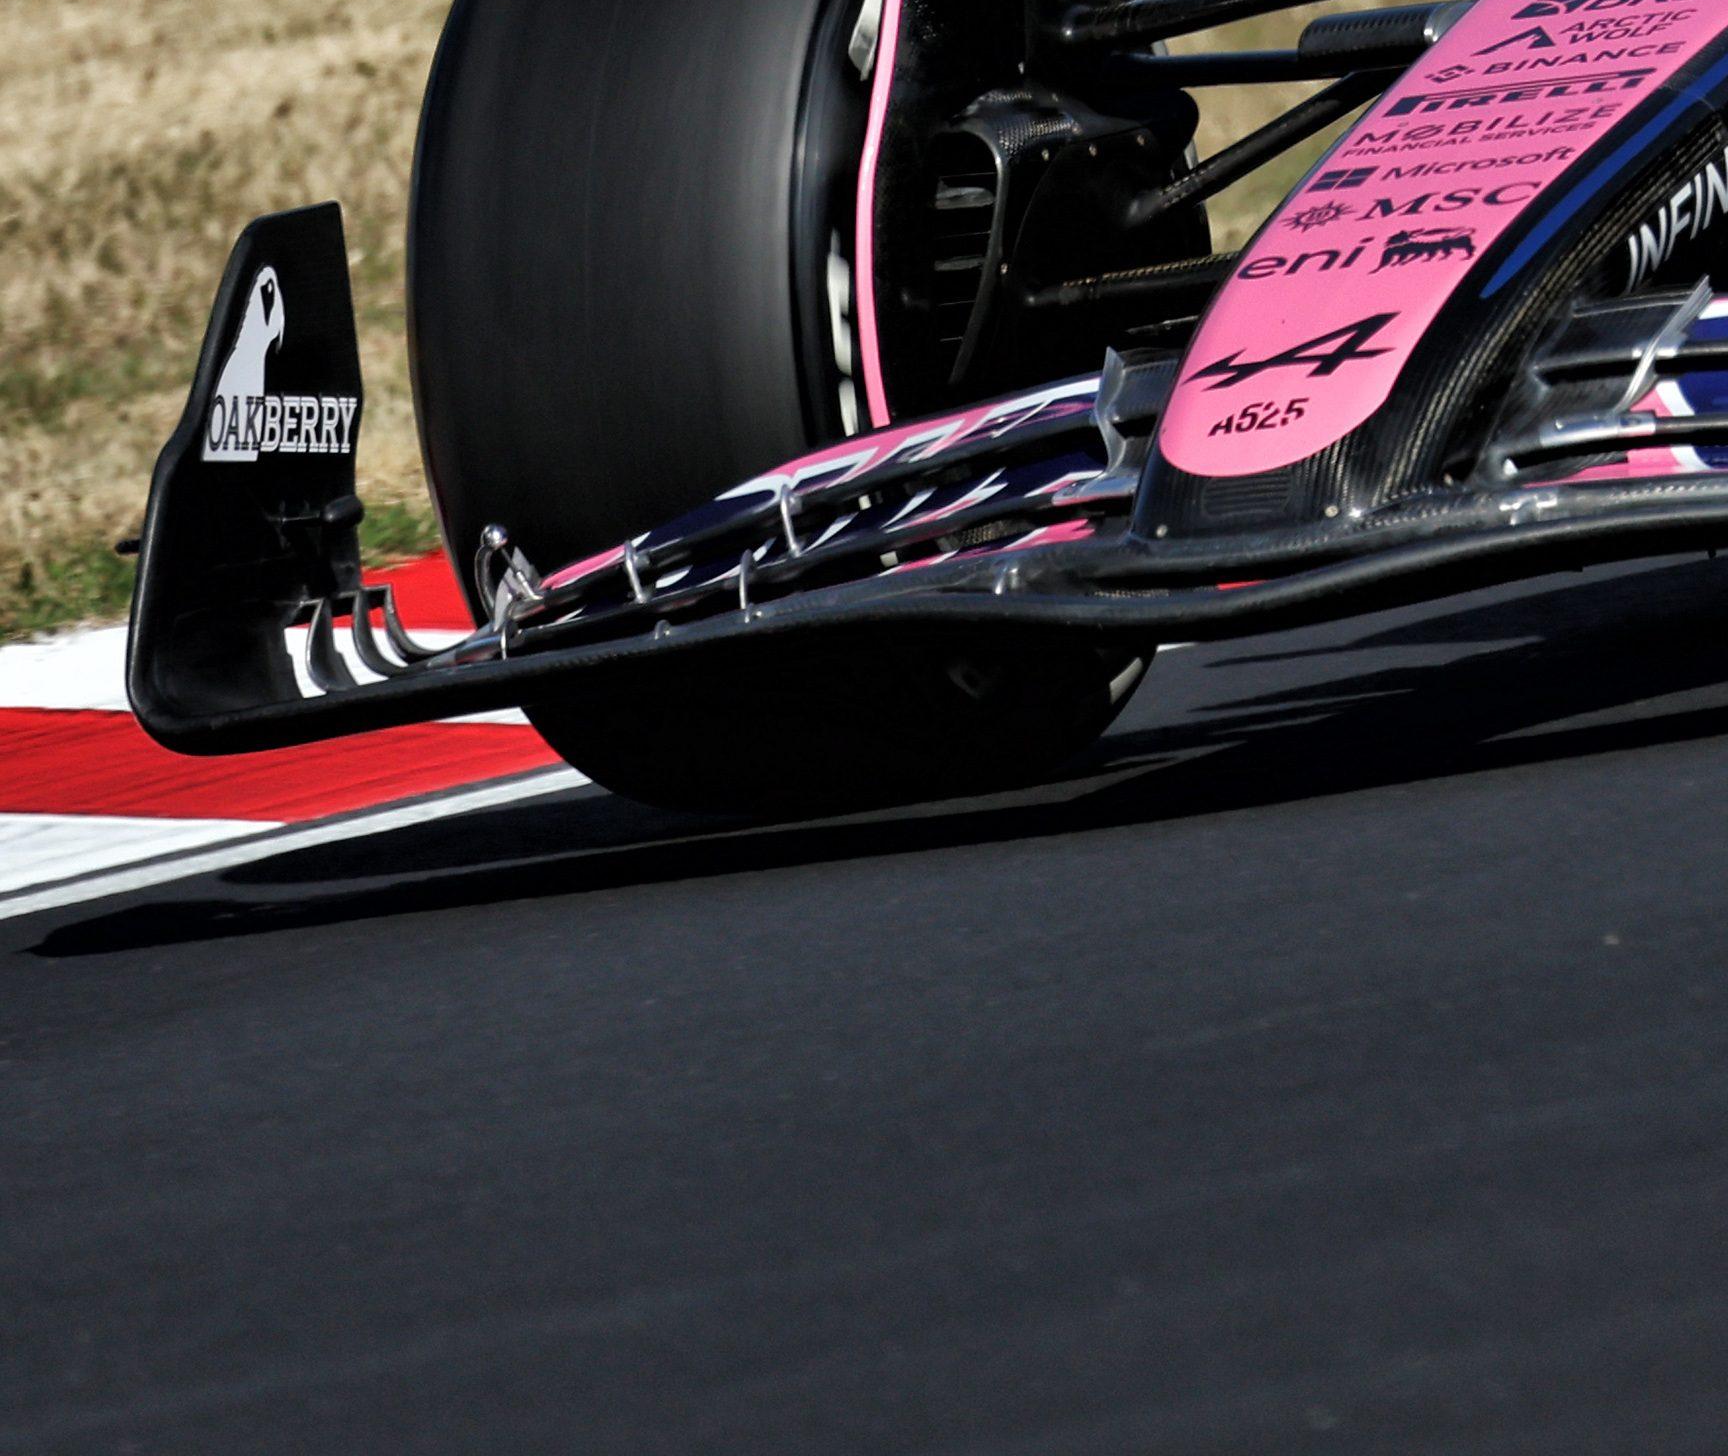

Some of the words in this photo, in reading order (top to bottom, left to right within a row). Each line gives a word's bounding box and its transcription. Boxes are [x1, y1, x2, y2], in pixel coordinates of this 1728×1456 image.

[1560, 8, 1698, 35] ARCTIC
[1568, 22, 1674, 45] WOLF
[1482, 40, 1688, 77] BINANCE
[1384, 67, 1658, 118] PIRELLI
[1342, 135, 1473, 158] FINANCIAL
[1477, 121, 1600, 142] SERVICES
[1380, 146, 1576, 181] Microsoft
[1355, 181, 1543, 221] MSC
[1237, 238, 1372, 281] eni
[208, 393, 359, 454] OAKBERRY
